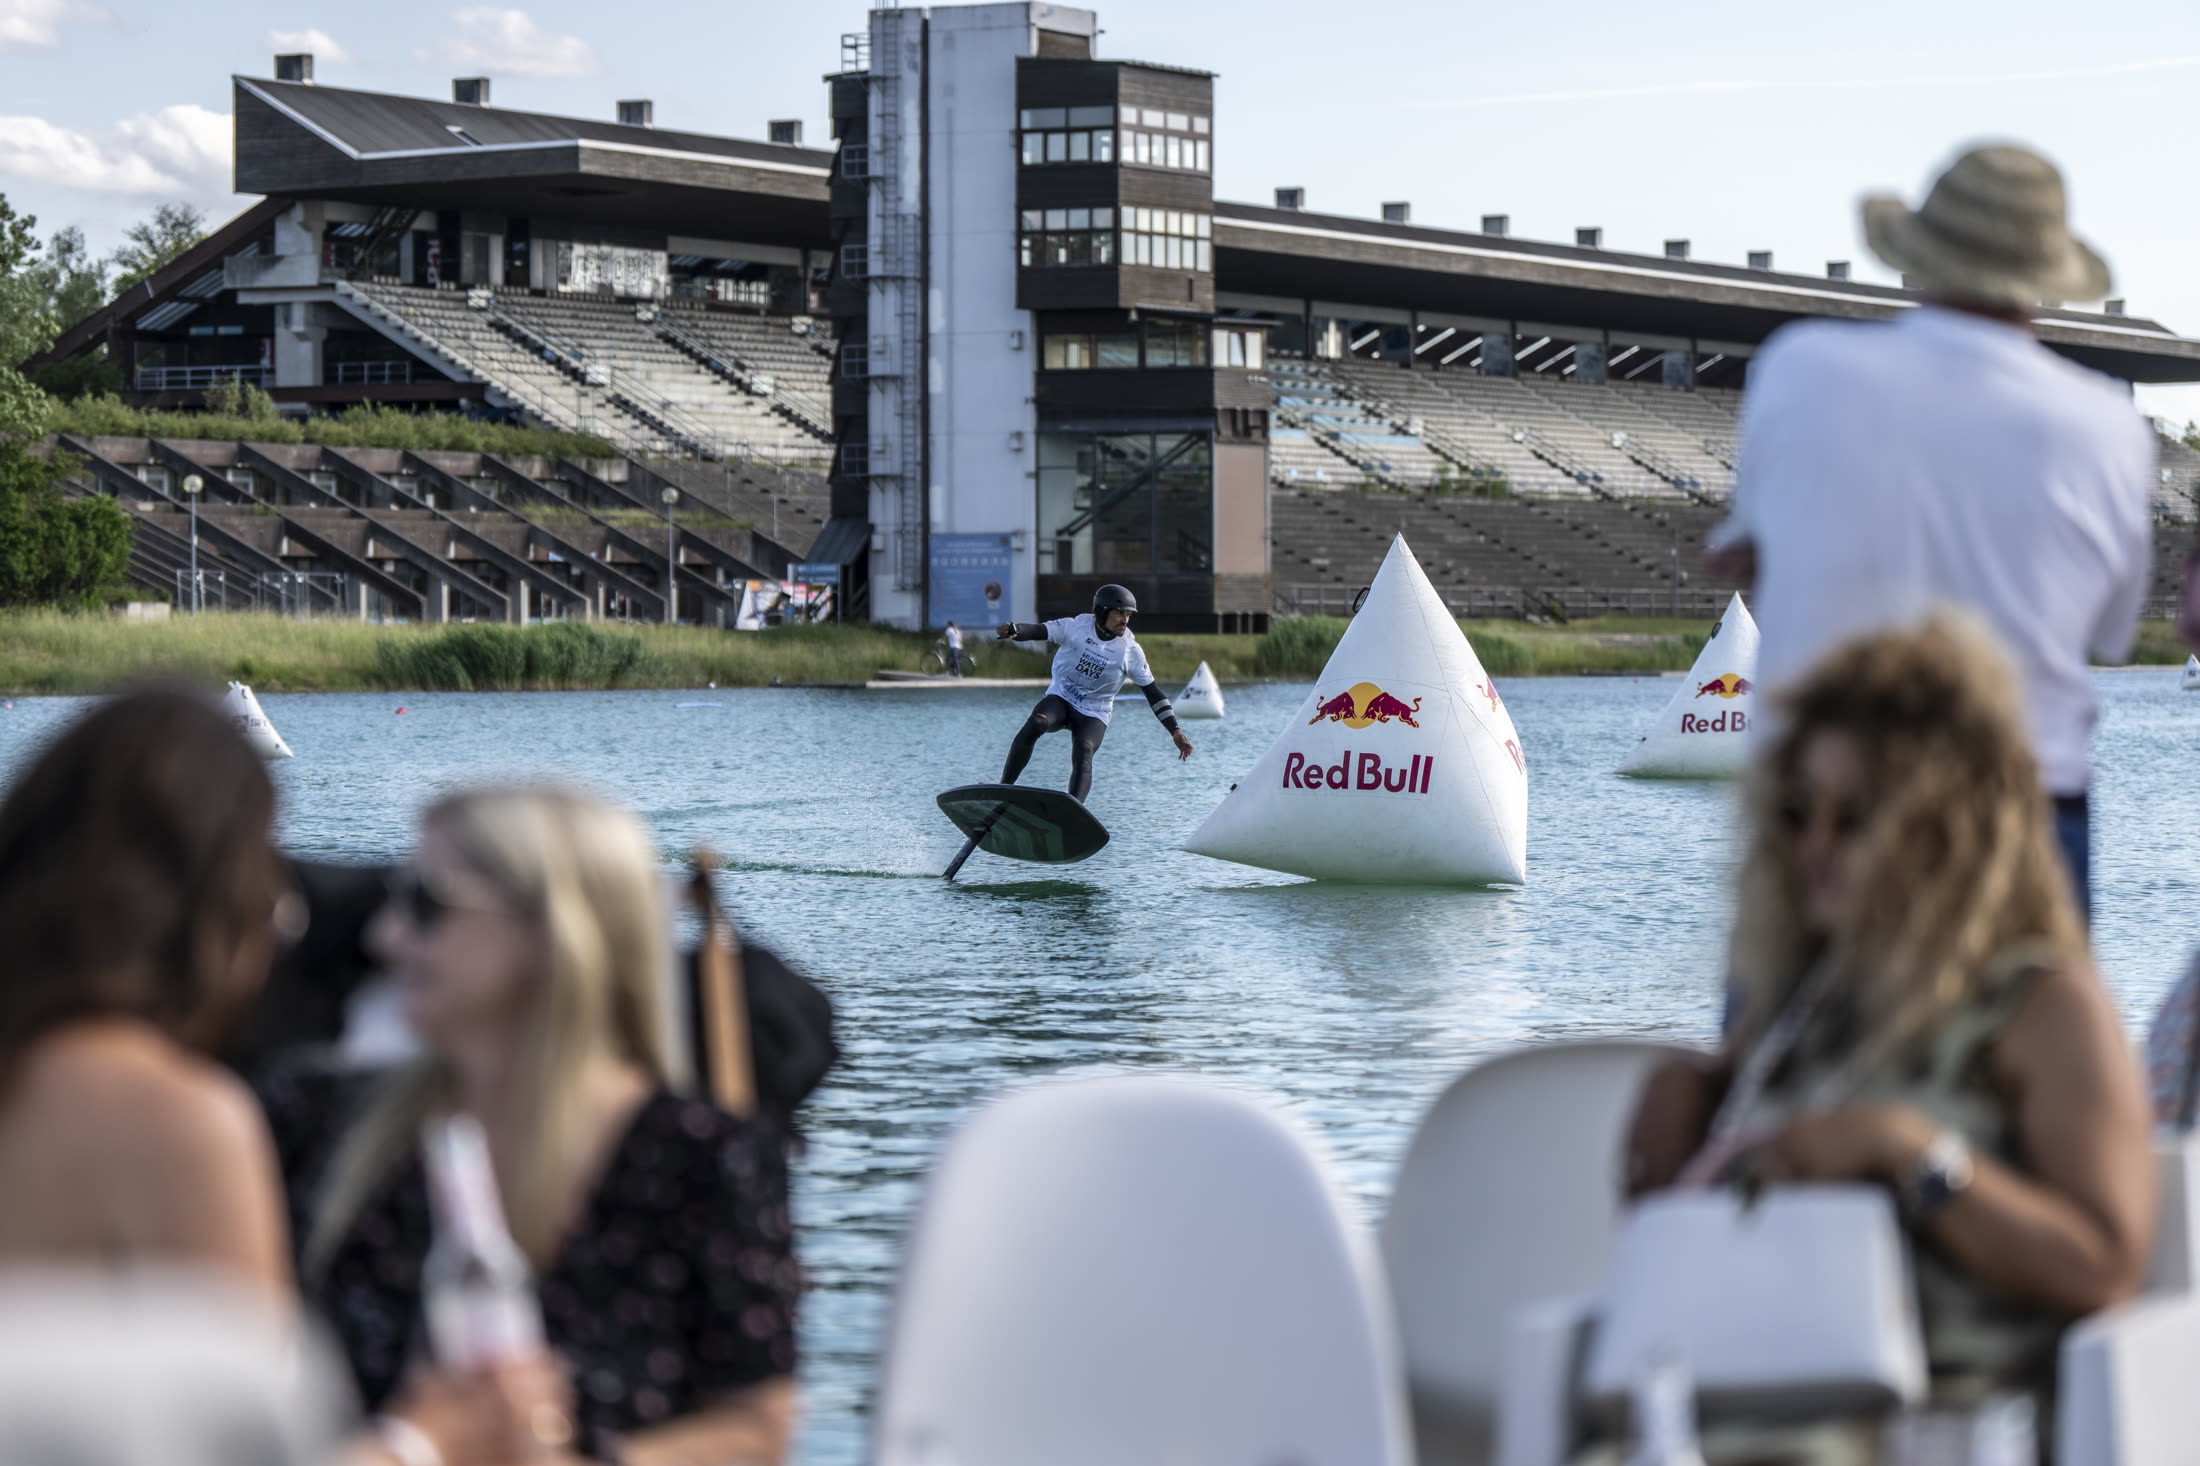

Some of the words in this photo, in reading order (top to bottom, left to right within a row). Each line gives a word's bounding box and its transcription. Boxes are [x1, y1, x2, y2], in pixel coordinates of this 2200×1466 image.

[1080, 657, 1105, 672] WATER
[1082, 652, 1107, 666] MUNICH
[1075, 663, 1101, 678] DAYS
[1681, 711, 1726, 734] Red
[1283, 751, 1351, 789] Red
[1357, 753, 1433, 794] Bull
